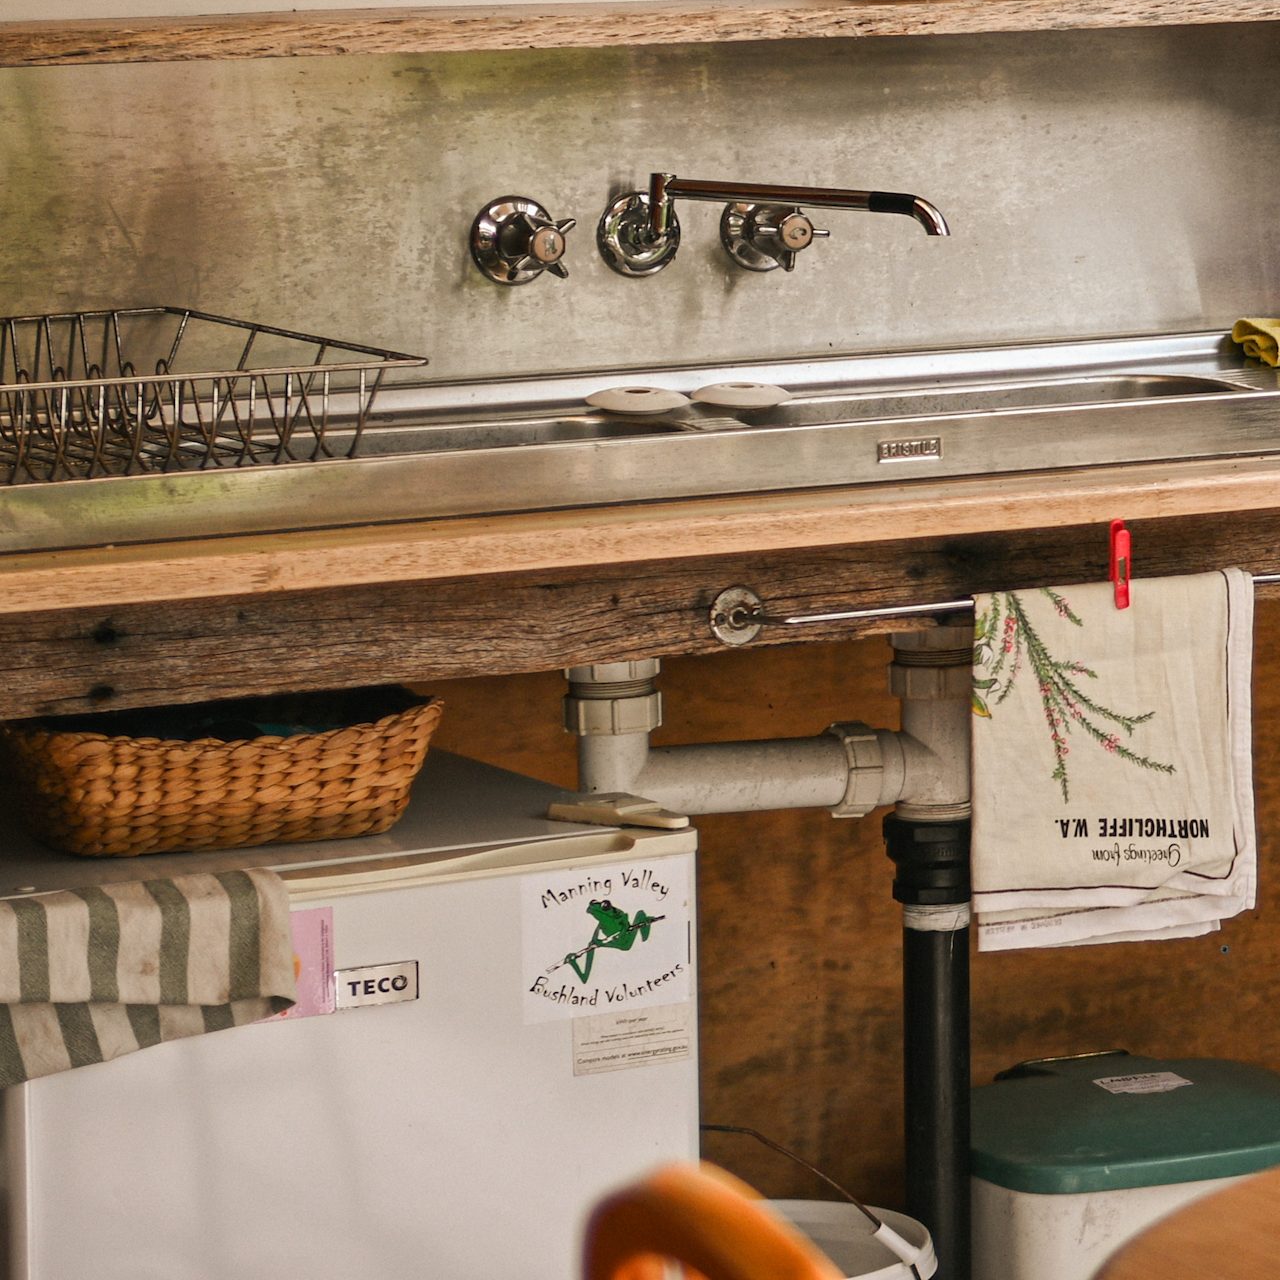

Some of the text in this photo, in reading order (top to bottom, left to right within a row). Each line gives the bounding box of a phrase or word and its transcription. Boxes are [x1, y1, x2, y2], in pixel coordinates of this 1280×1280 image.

[881, 440, 937, 457] BRISTILE
[1054, 818, 1210, 839] NORTHCLIFFE W.A.
[1091, 842, 1181, 867] Greetings from
[540, 869, 670, 909] Manning Valley
[347, 975, 408, 996] TECO
[529, 963, 685, 1008] Bushland Volunteers
